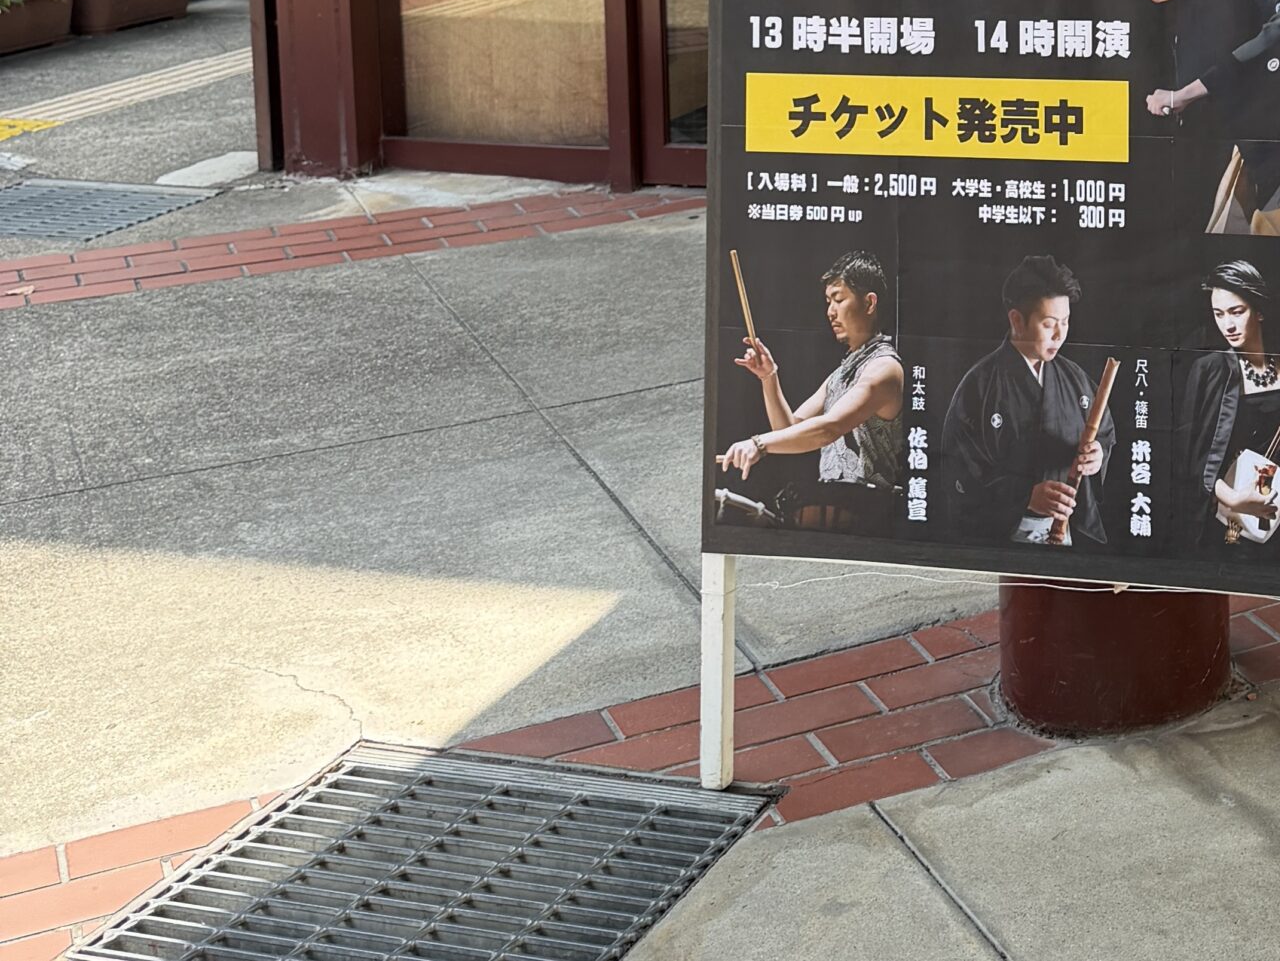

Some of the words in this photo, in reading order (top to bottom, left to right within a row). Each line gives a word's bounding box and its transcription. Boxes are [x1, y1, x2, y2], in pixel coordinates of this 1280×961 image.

[787, 92, 1085, 146] チケット発売中
[912, 365, 926, 411] 和太鼓
[1135, 359, 1149, 429] 尺八・篠笛
